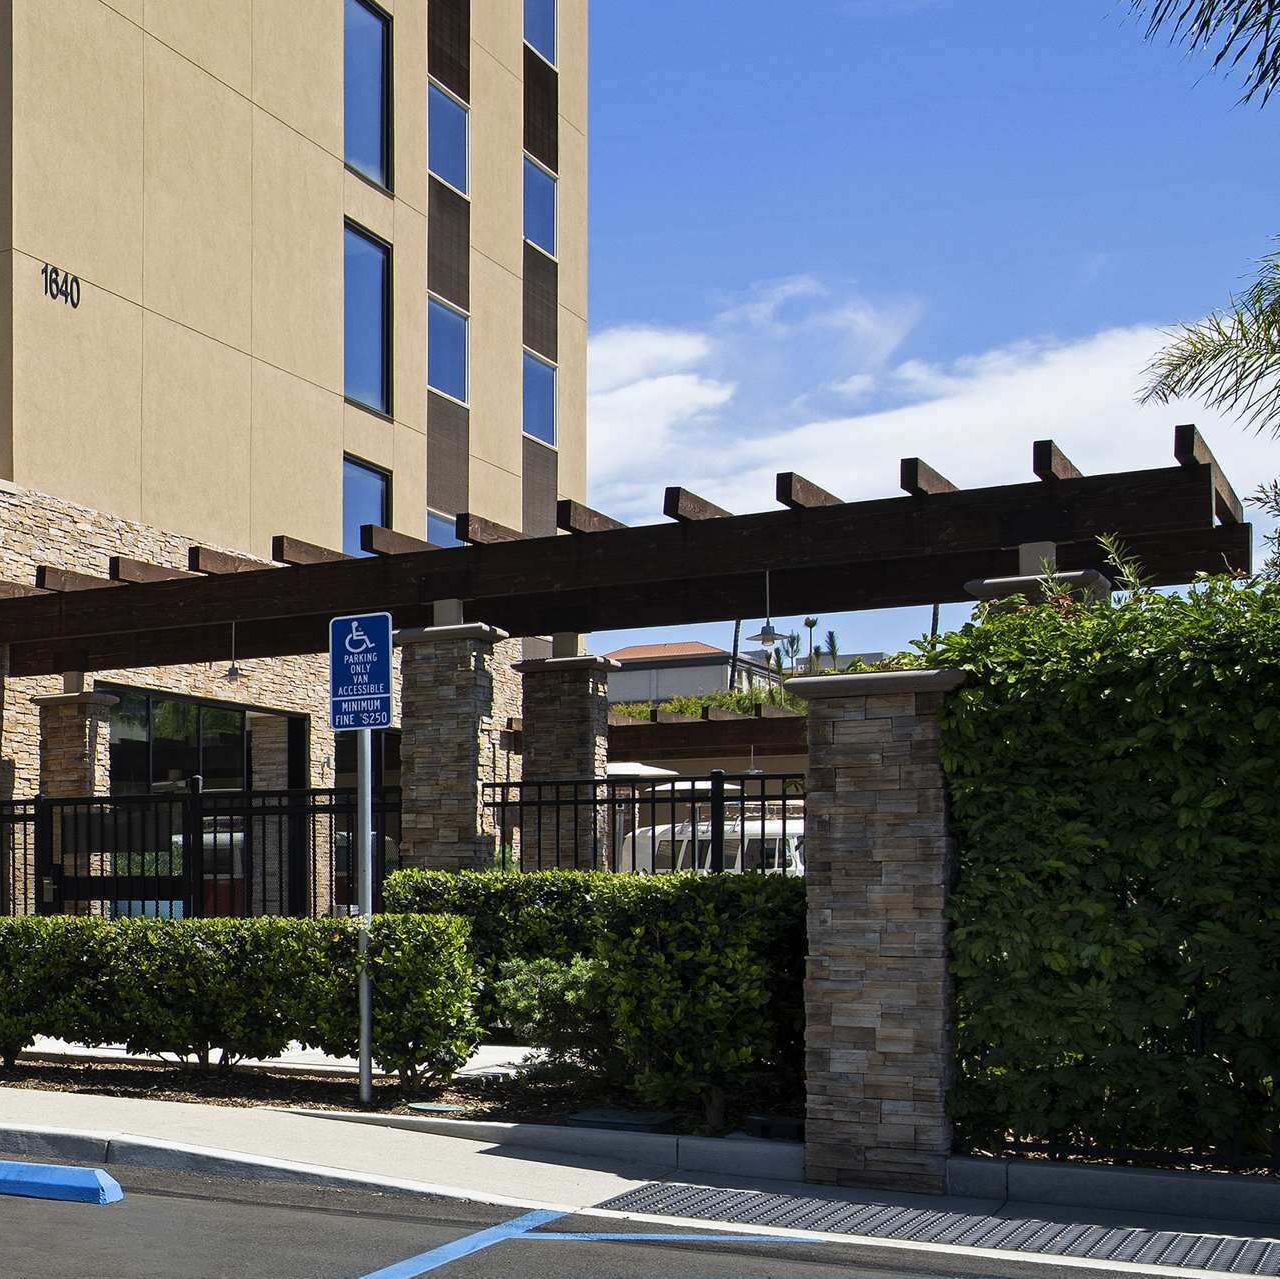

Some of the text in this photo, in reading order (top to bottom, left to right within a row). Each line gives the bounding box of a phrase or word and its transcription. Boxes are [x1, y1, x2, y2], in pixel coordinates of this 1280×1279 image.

[42, 263, 80, 309] 1640
[344, 653, 377, 664] PARKING
[351, 664, 371, 674] ONLY
[353, 674, 368, 684] VAN
[338, 684, 384, 696] ACCESSIBLE
[342, 700, 380, 712] MINIMUM
[335, 712, 387, 726] FINE $250
